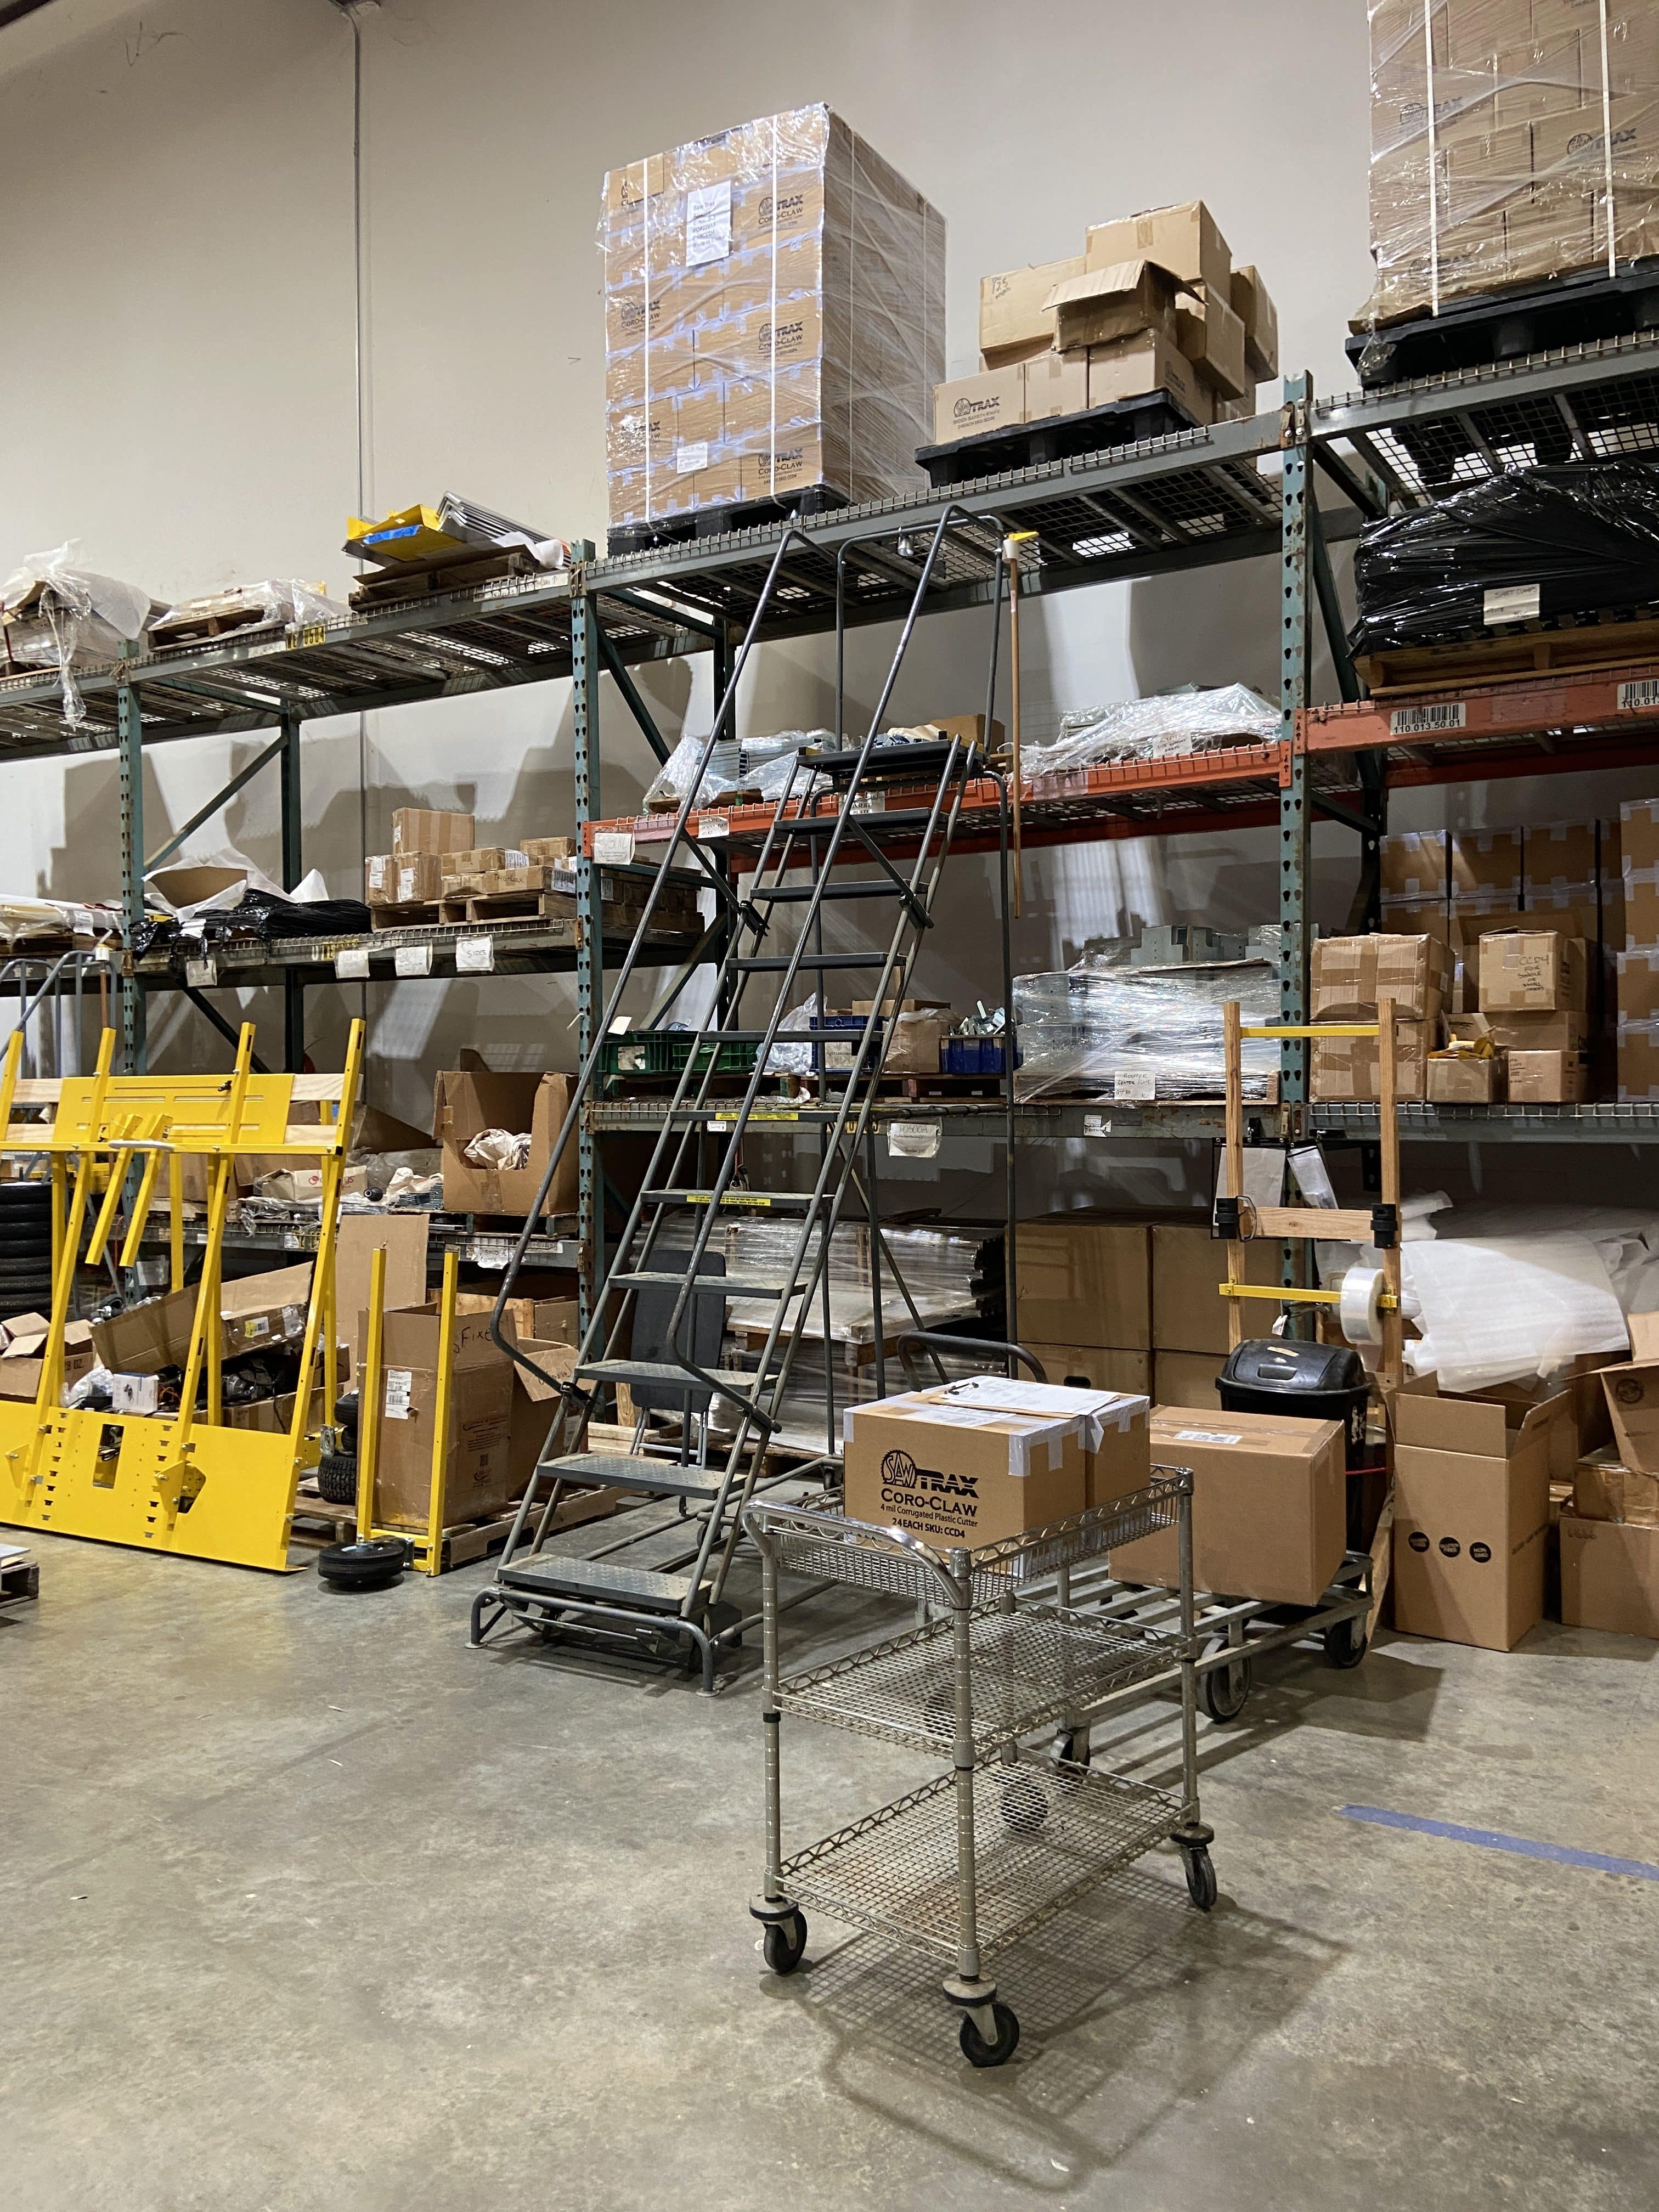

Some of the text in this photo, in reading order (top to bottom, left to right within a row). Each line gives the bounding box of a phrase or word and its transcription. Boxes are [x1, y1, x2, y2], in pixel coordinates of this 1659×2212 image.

[1622, 696, 1659, 708] 110.01
[1394, 719, 1460, 733] 110.013.50.01
[914, 1468, 979, 1499] TRAX
[881, 1488, 978, 1517] CORO-CLAW
[881, 1503, 978, 1528] 4 mil Corrugated Plastic Cutter
[924, 1523, 943, 1534] SKU:
[944, 1527, 966, 1538] CCD4
